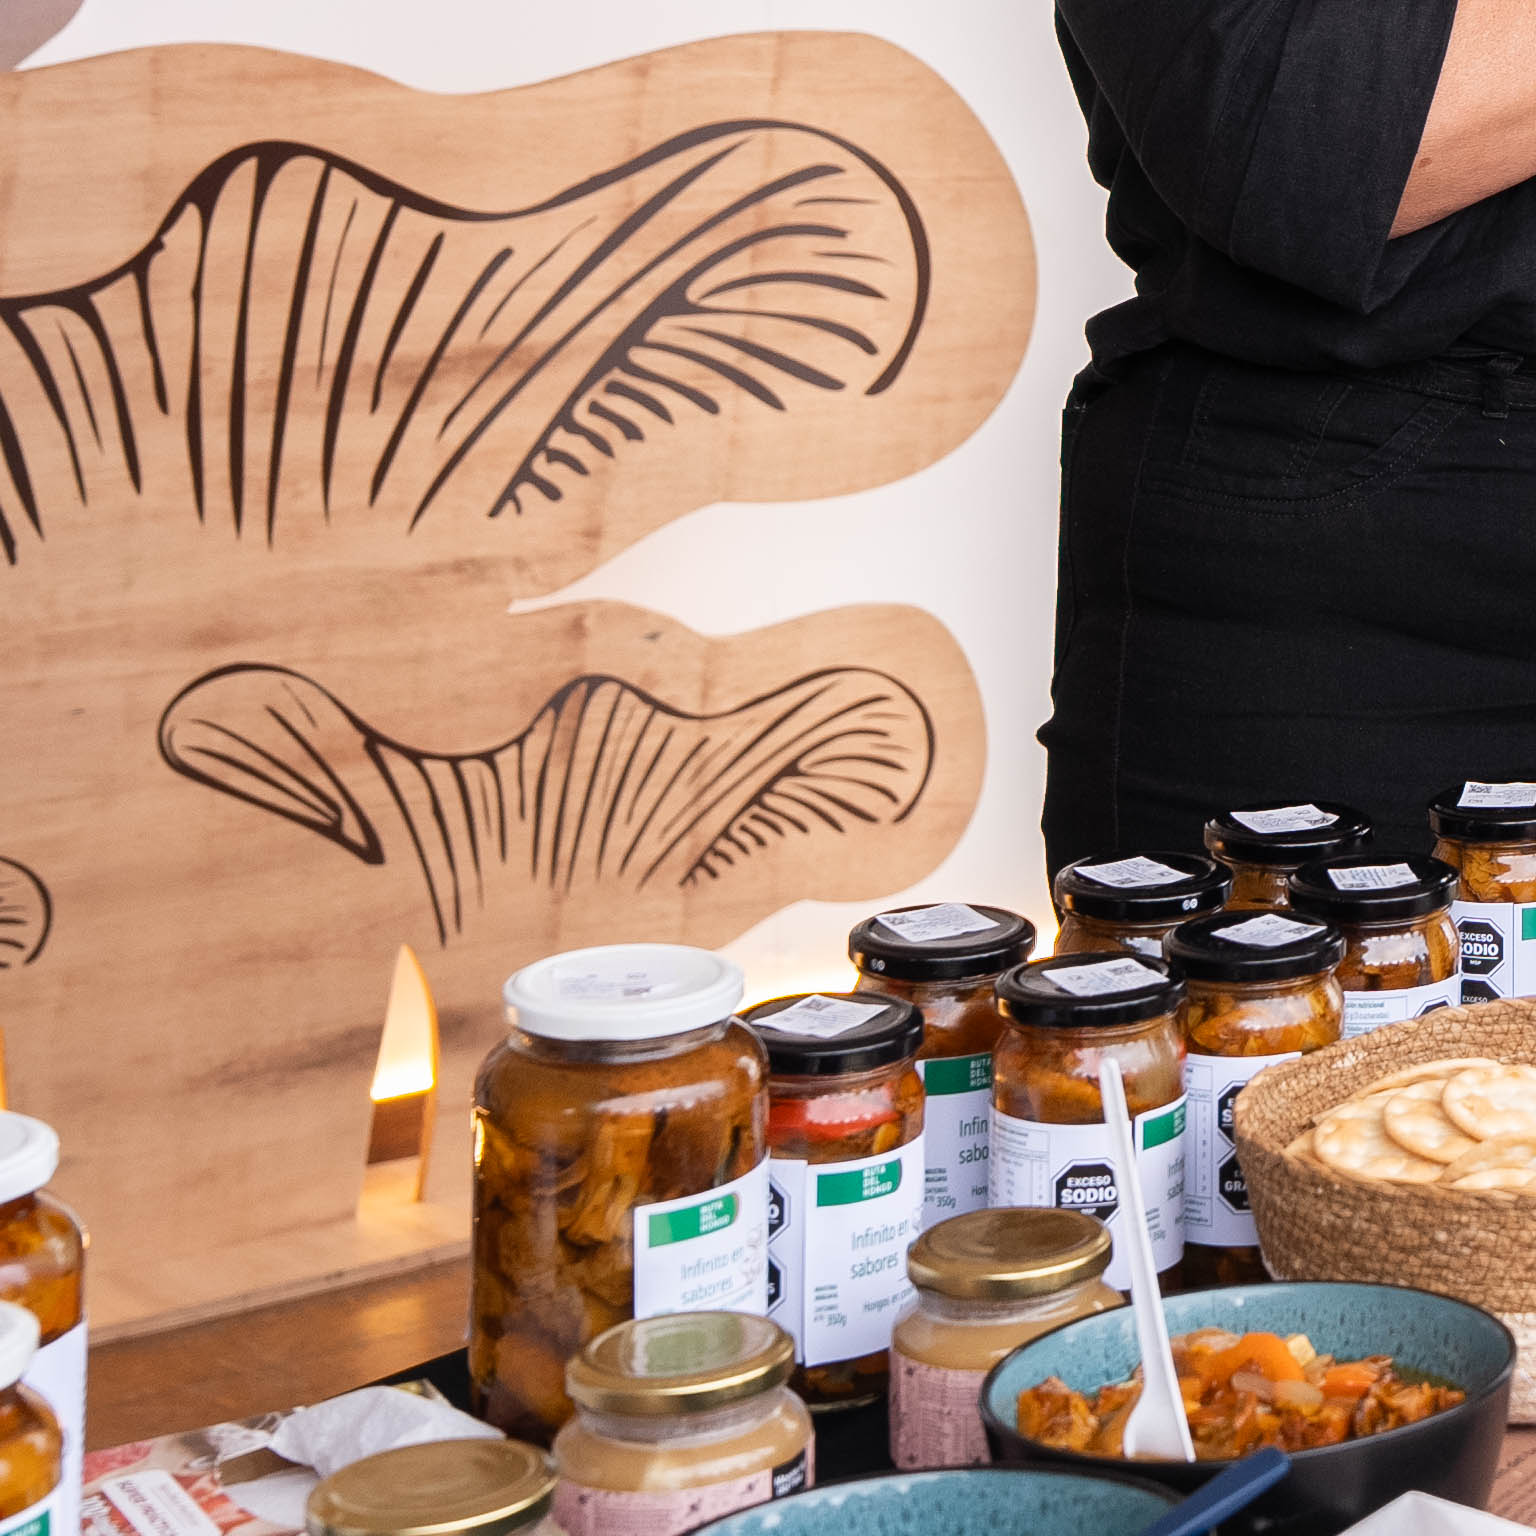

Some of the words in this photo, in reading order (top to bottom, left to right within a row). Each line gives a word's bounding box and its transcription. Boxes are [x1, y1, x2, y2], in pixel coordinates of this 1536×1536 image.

[1459, 931, 1494, 943] EXCESO
[970, 1068, 986, 1079] DEL
[958, 1117, 989, 1138] Infin
[958, 1143, 989, 1165] sabo
[1066, 1175, 1112, 1189] EXCESO
[1060, 1186, 1118, 1204] SODIO
[850, 1225, 896, 1251] Infinito
[850, 1252, 899, 1279] sabores
[681, 1275, 734, 1305] sabores
